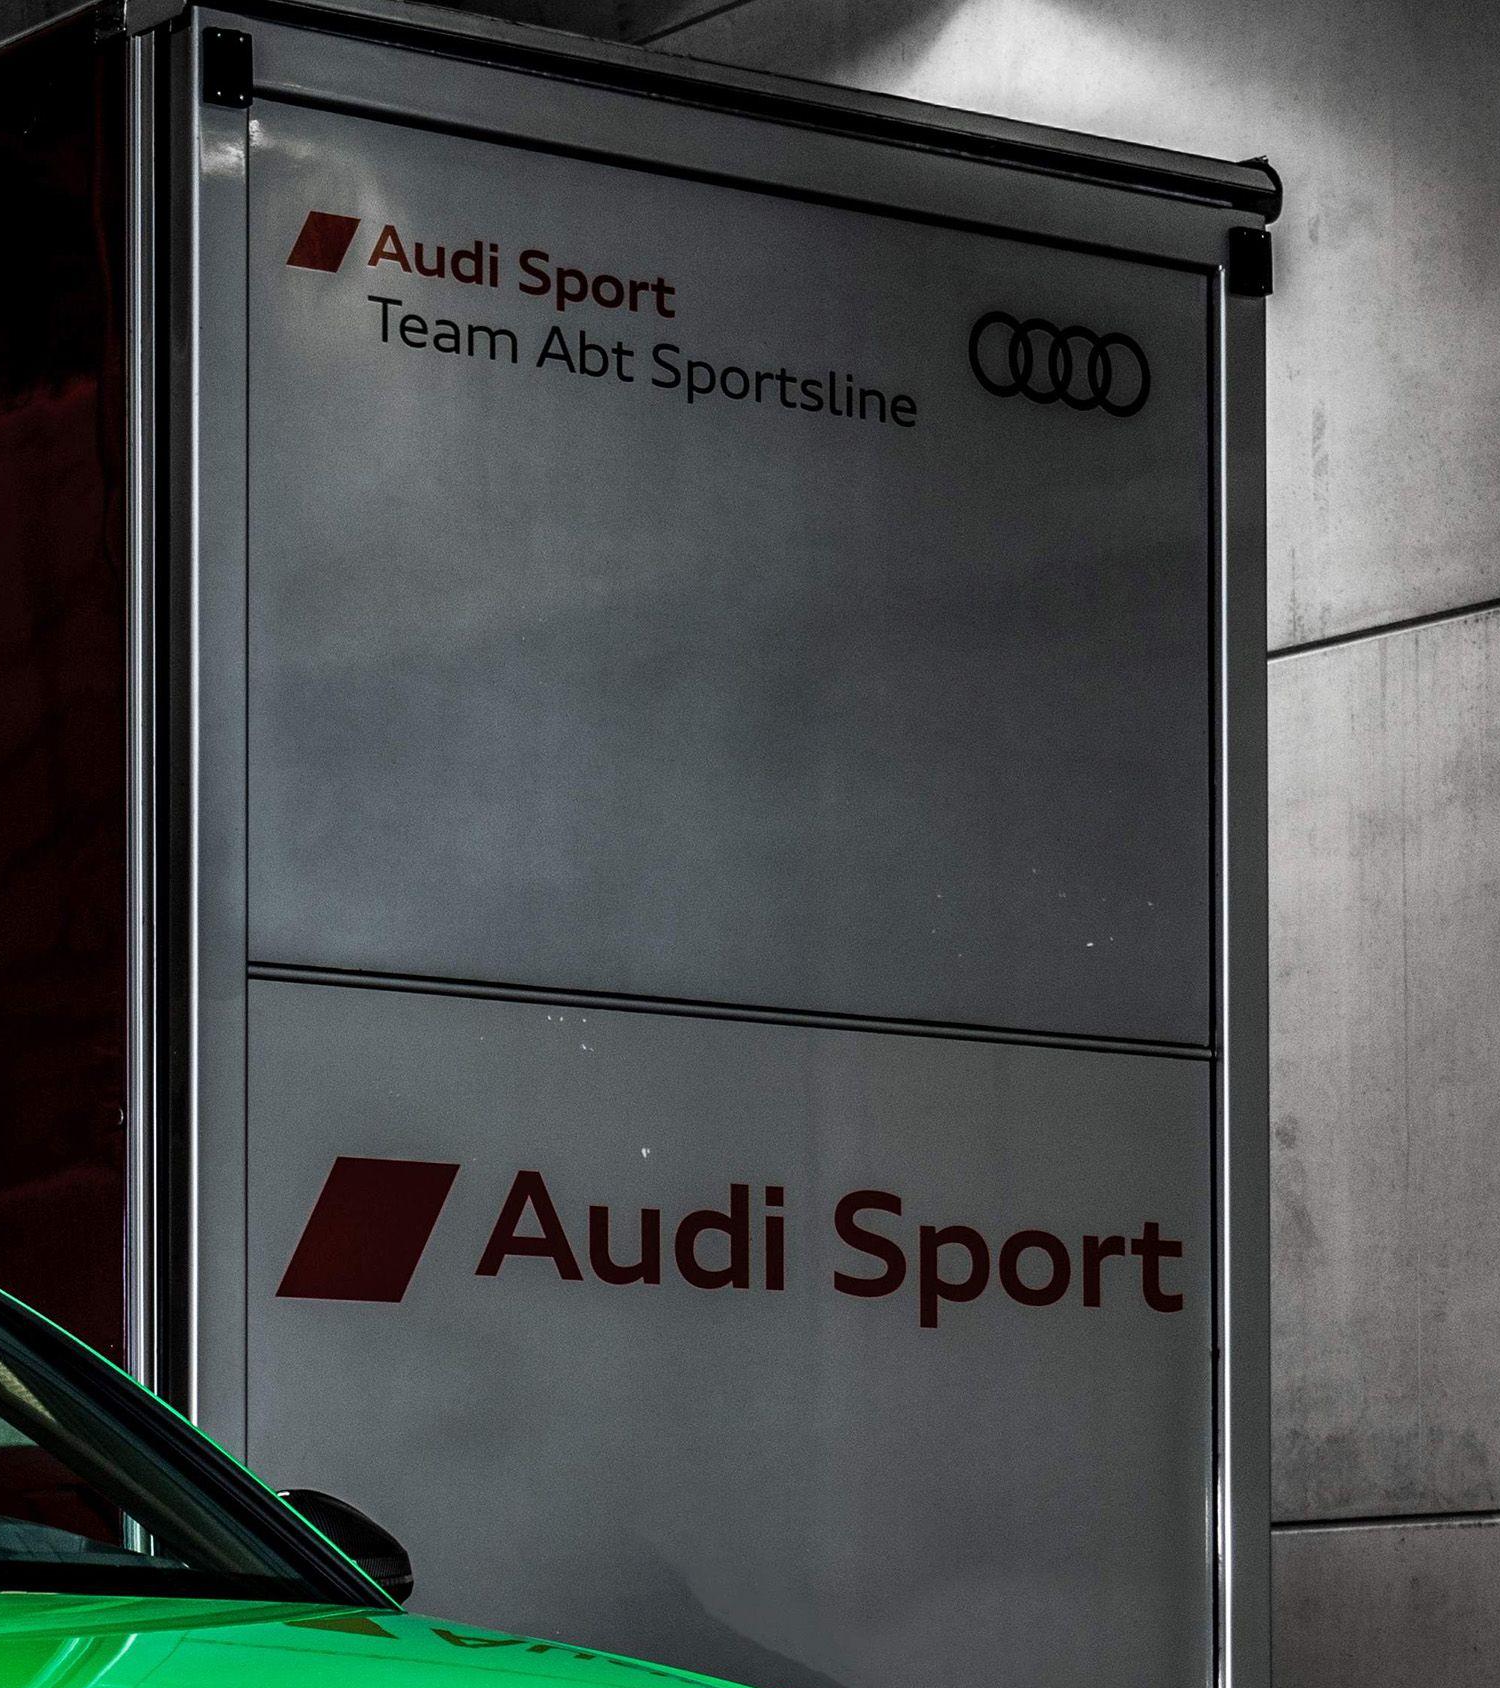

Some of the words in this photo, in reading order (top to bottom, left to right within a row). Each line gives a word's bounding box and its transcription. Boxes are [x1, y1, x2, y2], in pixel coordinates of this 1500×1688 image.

[367, 224, 500, 289] Audi
[518, 249, 676, 318] Sport
[367, 295, 519, 365] Team
[536, 326, 635, 384] Abt
[651, 342, 917, 428] Sportsline
[475, 1170, 785, 1291] Audi
[832, 1189, 1184, 1329] Sport
